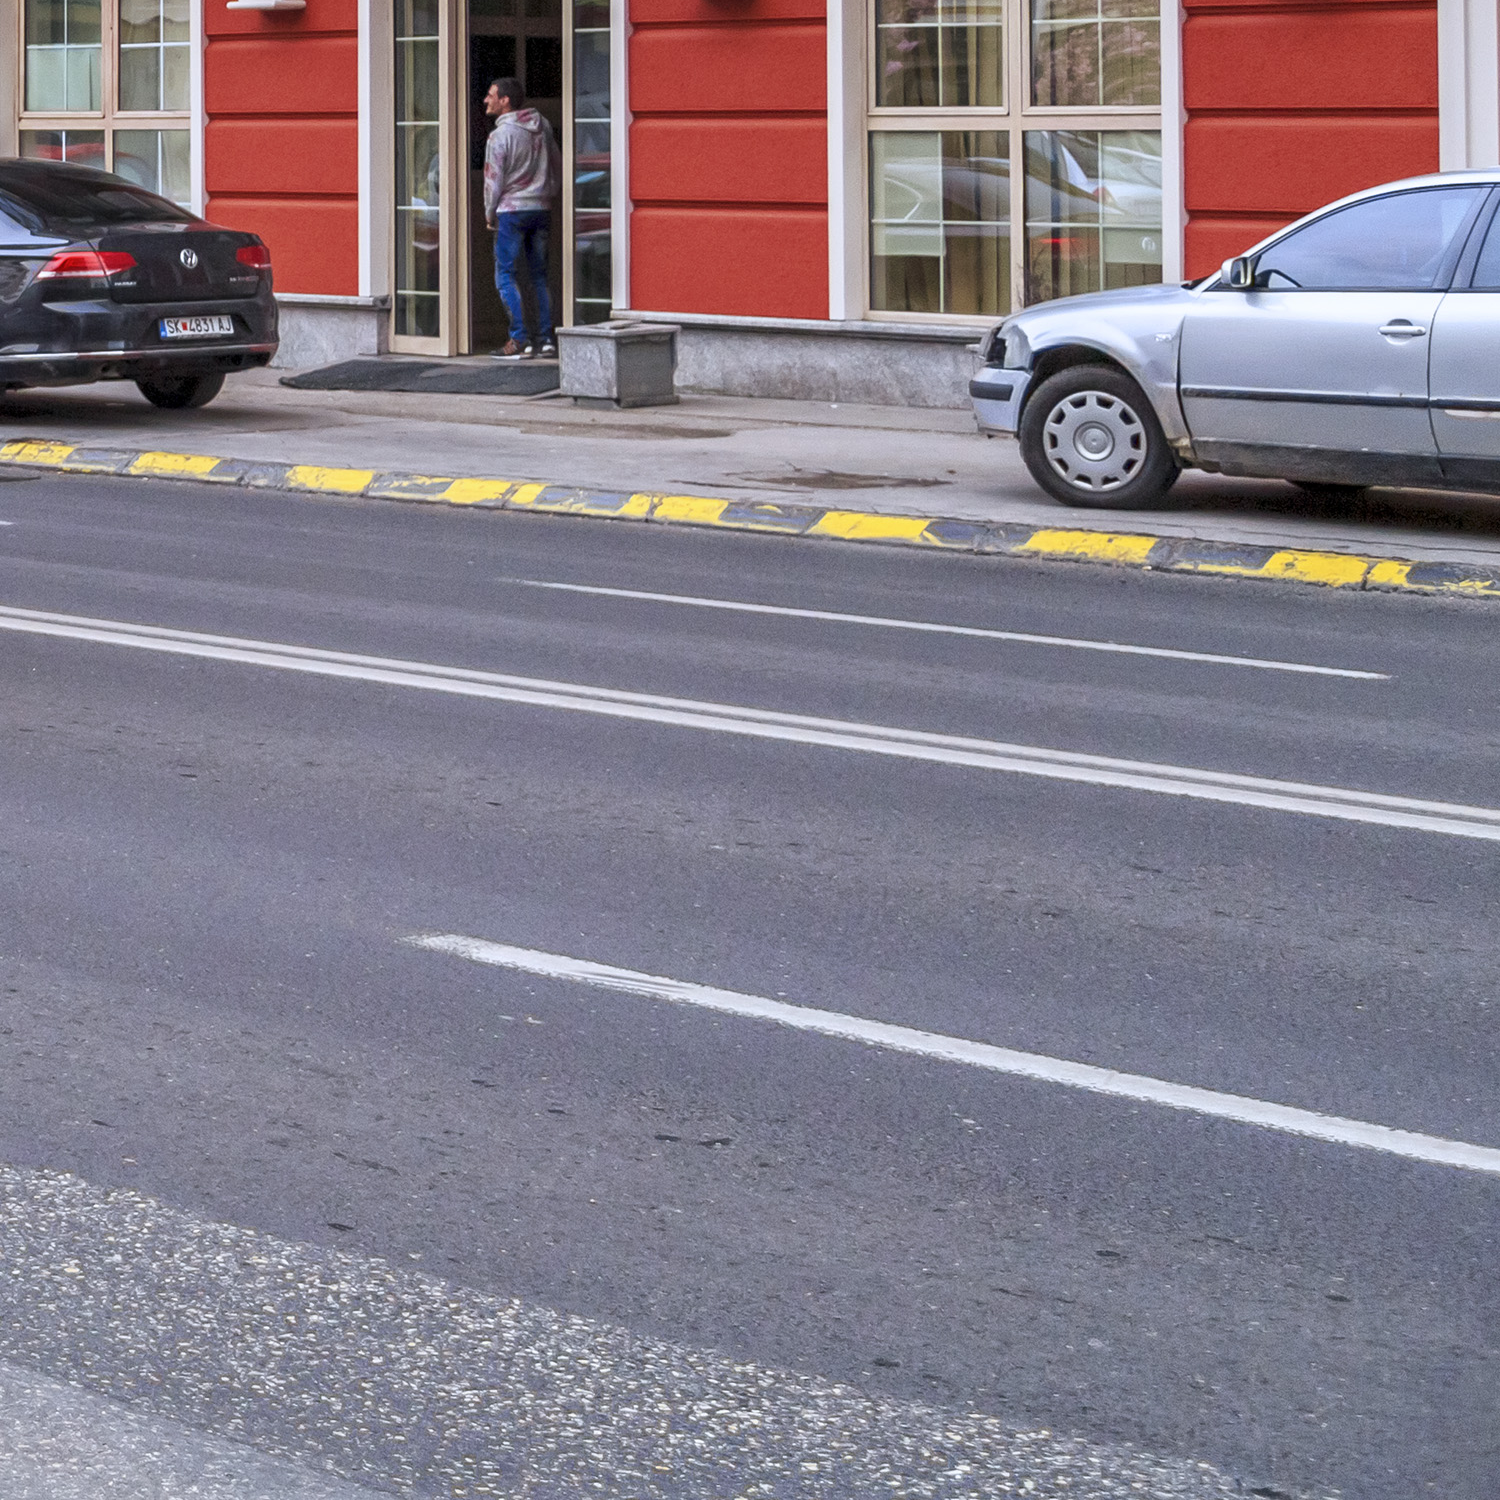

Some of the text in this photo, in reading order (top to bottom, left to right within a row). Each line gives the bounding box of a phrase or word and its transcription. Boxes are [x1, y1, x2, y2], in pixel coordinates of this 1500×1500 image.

[166, 317, 232, 334] SK 4831 AJ
